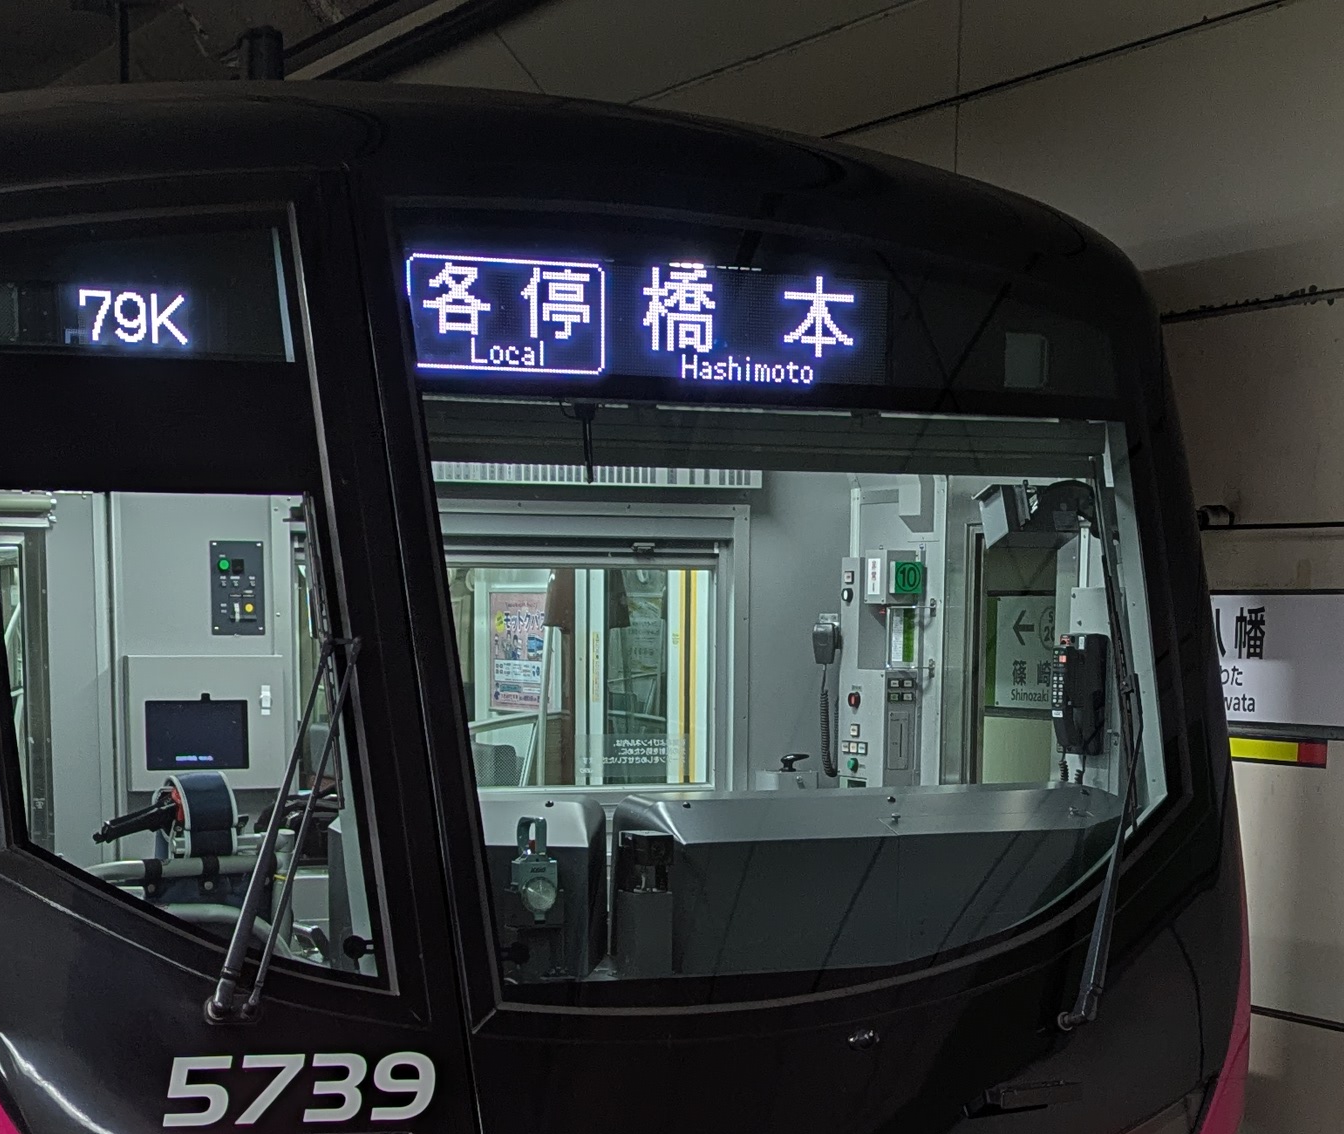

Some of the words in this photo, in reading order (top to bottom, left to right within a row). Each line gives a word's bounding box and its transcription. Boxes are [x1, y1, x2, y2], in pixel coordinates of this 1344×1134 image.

[79, 289, 188, 346] 79K
[422, 262, 591, 340] 各停
[641, 265, 855, 358] 橋本
[470, 337, 545, 367] Local
[681, 355, 814, 384] Hashimoto
[1012, 660, 1051, 687] 篠崎
[1011, 689, 1049, 702] Shinozaki
[162, 1051, 436, 1127] 5739
